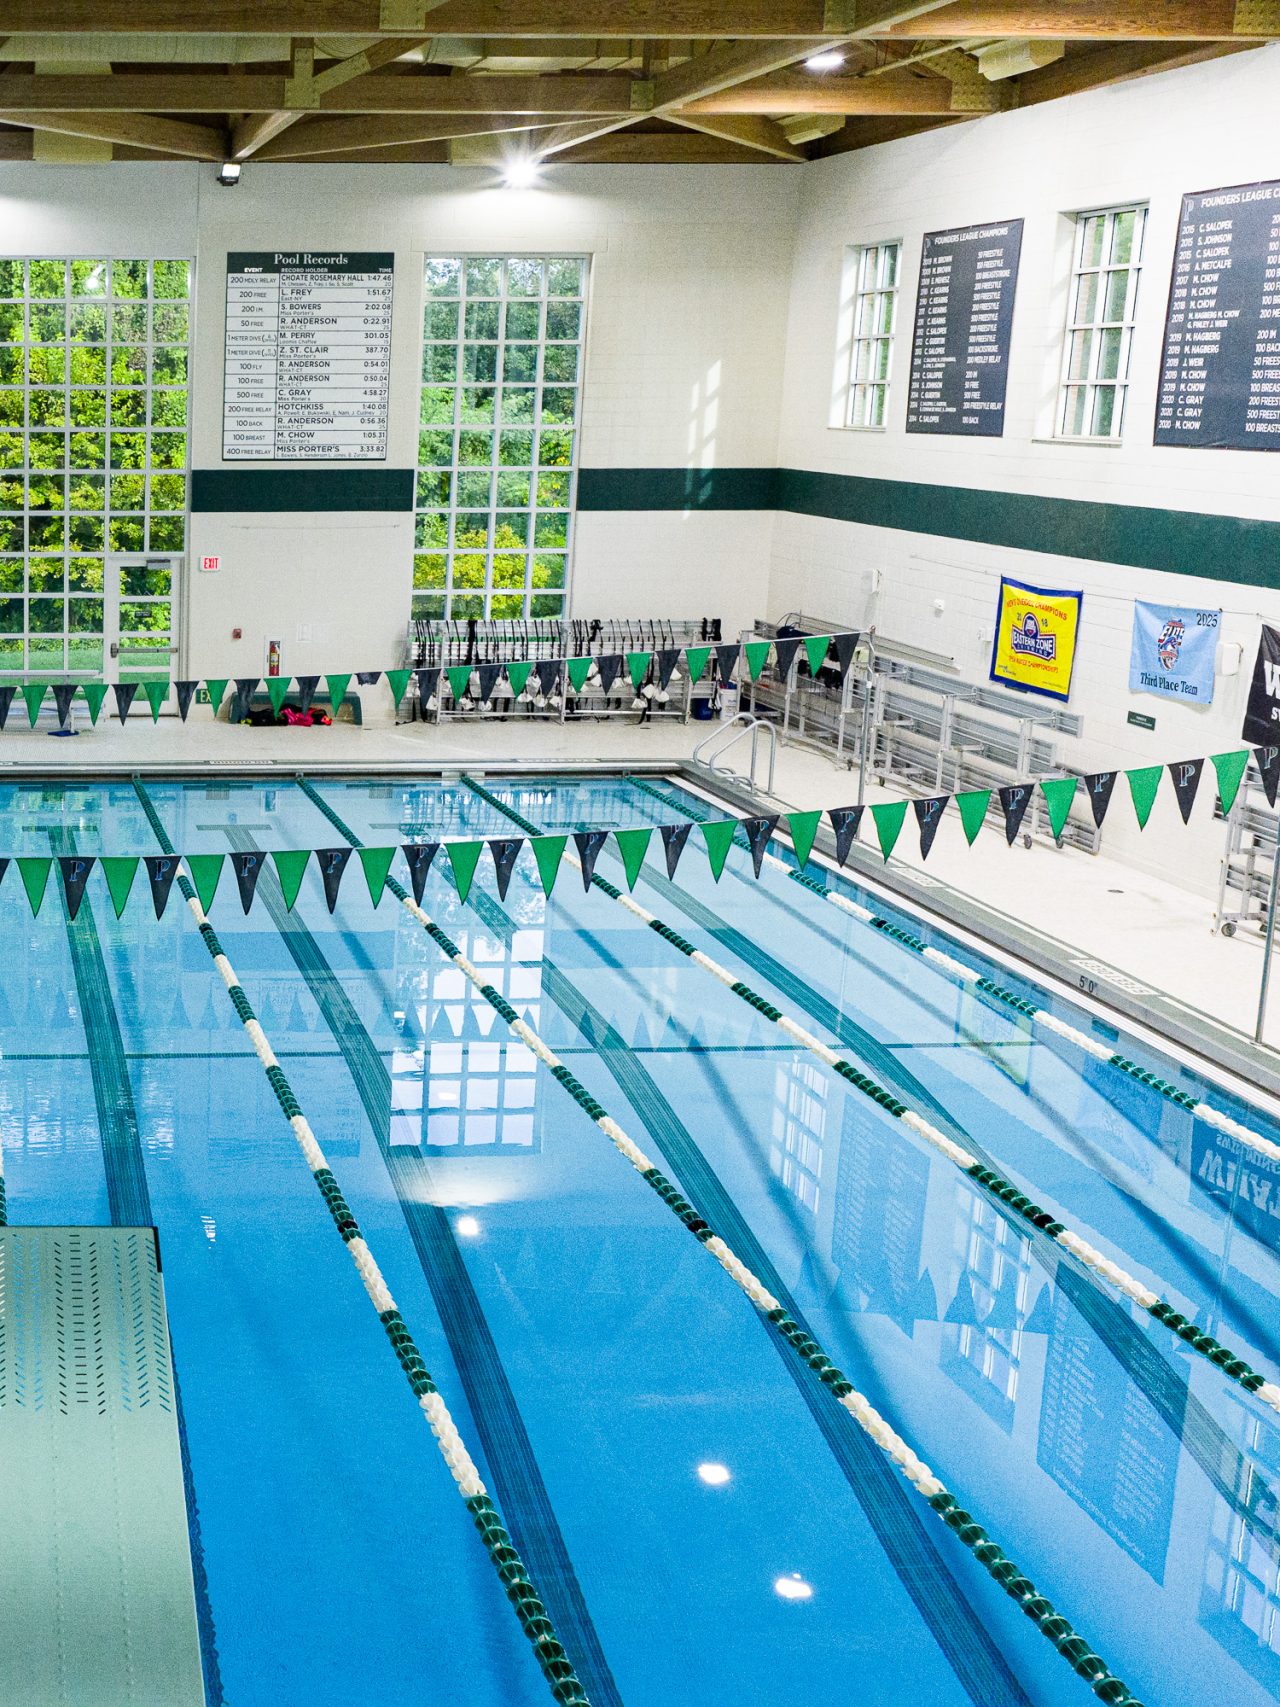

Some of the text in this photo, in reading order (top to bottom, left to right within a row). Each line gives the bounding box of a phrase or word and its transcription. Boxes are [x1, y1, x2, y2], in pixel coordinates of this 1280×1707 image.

[1201, 195, 1240, 207] FOUNDERS
[1242, 190, 1272, 201] LEAGUE
[935, 227, 1008, 245] FOUNDERS LEAGUE CHAMPIONS
[275, 254, 348, 264] Pool Records
[1201, 273, 1219, 283] CHOW
[1199, 287, 1217, 295] CHOW
[1198, 300, 1216, 308] CHOW
[1189, 371, 1207, 379] CHOW
[1186, 396, 1204, 404] GRAY
[1184, 408, 1202, 416] GRAY
[1183, 421, 1200, 429] CHOW
[204, 558, 219, 569] EXIT
[1197, 613, 1217, 627] 2025
[1014, 632, 1036, 646] EASTERN
[1036, 640, 1052, 652] ZONE
[1140, 673, 1197, 695] Third Place Team
